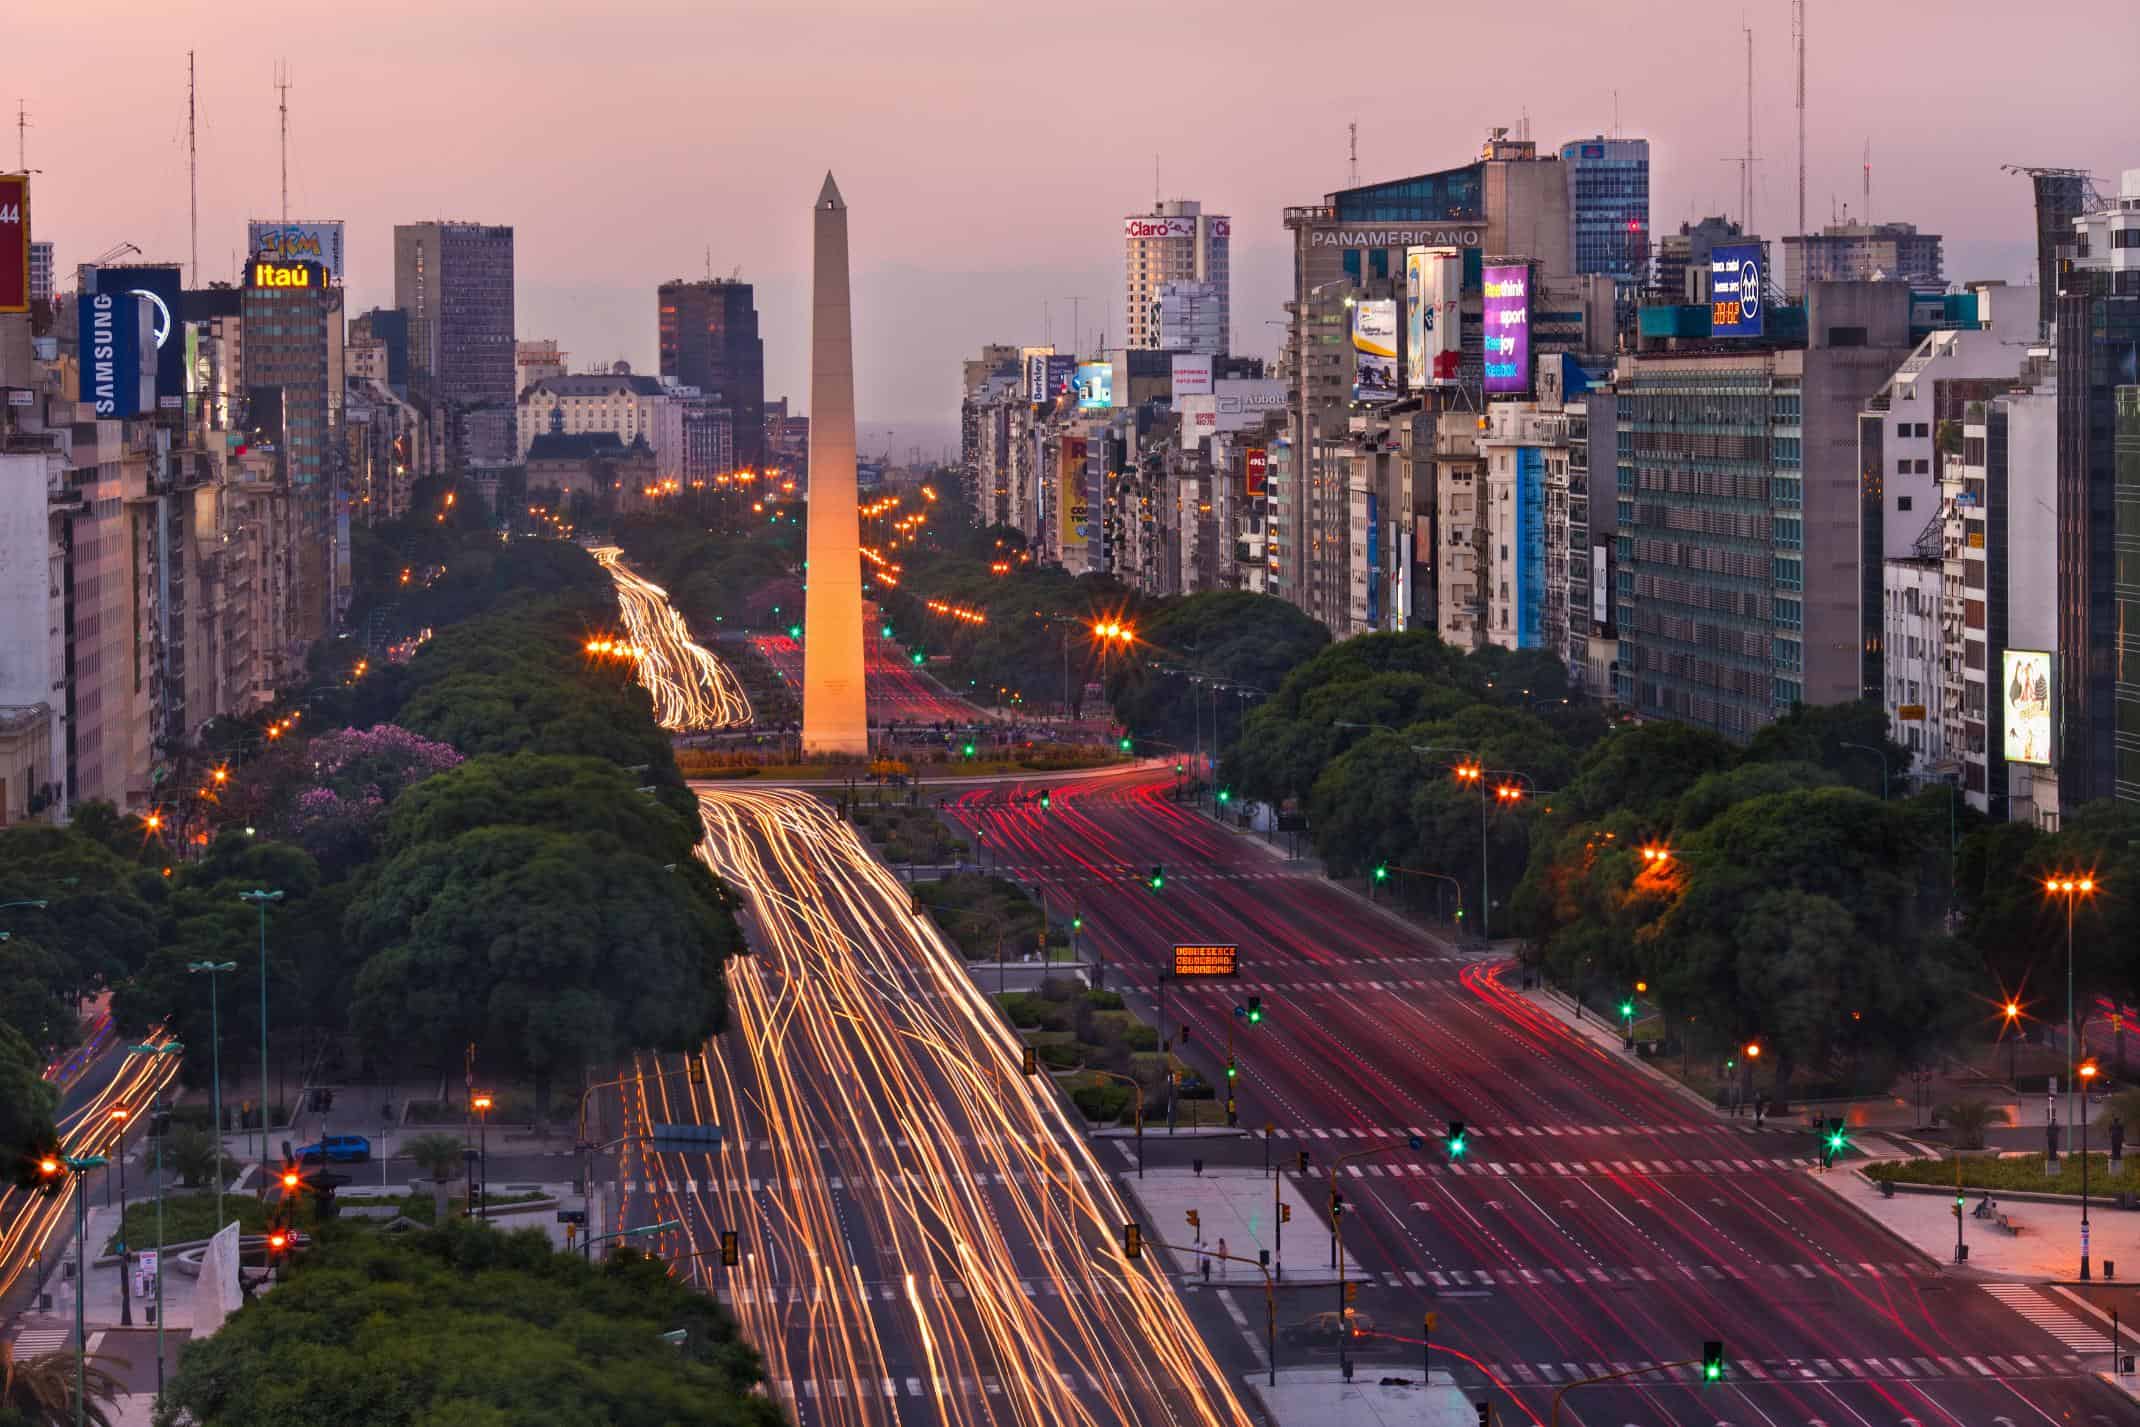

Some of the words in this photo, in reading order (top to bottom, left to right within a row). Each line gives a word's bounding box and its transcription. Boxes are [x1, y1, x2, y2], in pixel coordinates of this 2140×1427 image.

[1130, 221, 1169, 237] Claro
[1311, 230, 1478, 247] PANAMERICANO
[256, 264, 308, 287] Itaú
[94, 294, 114, 413] SAMSUNG
